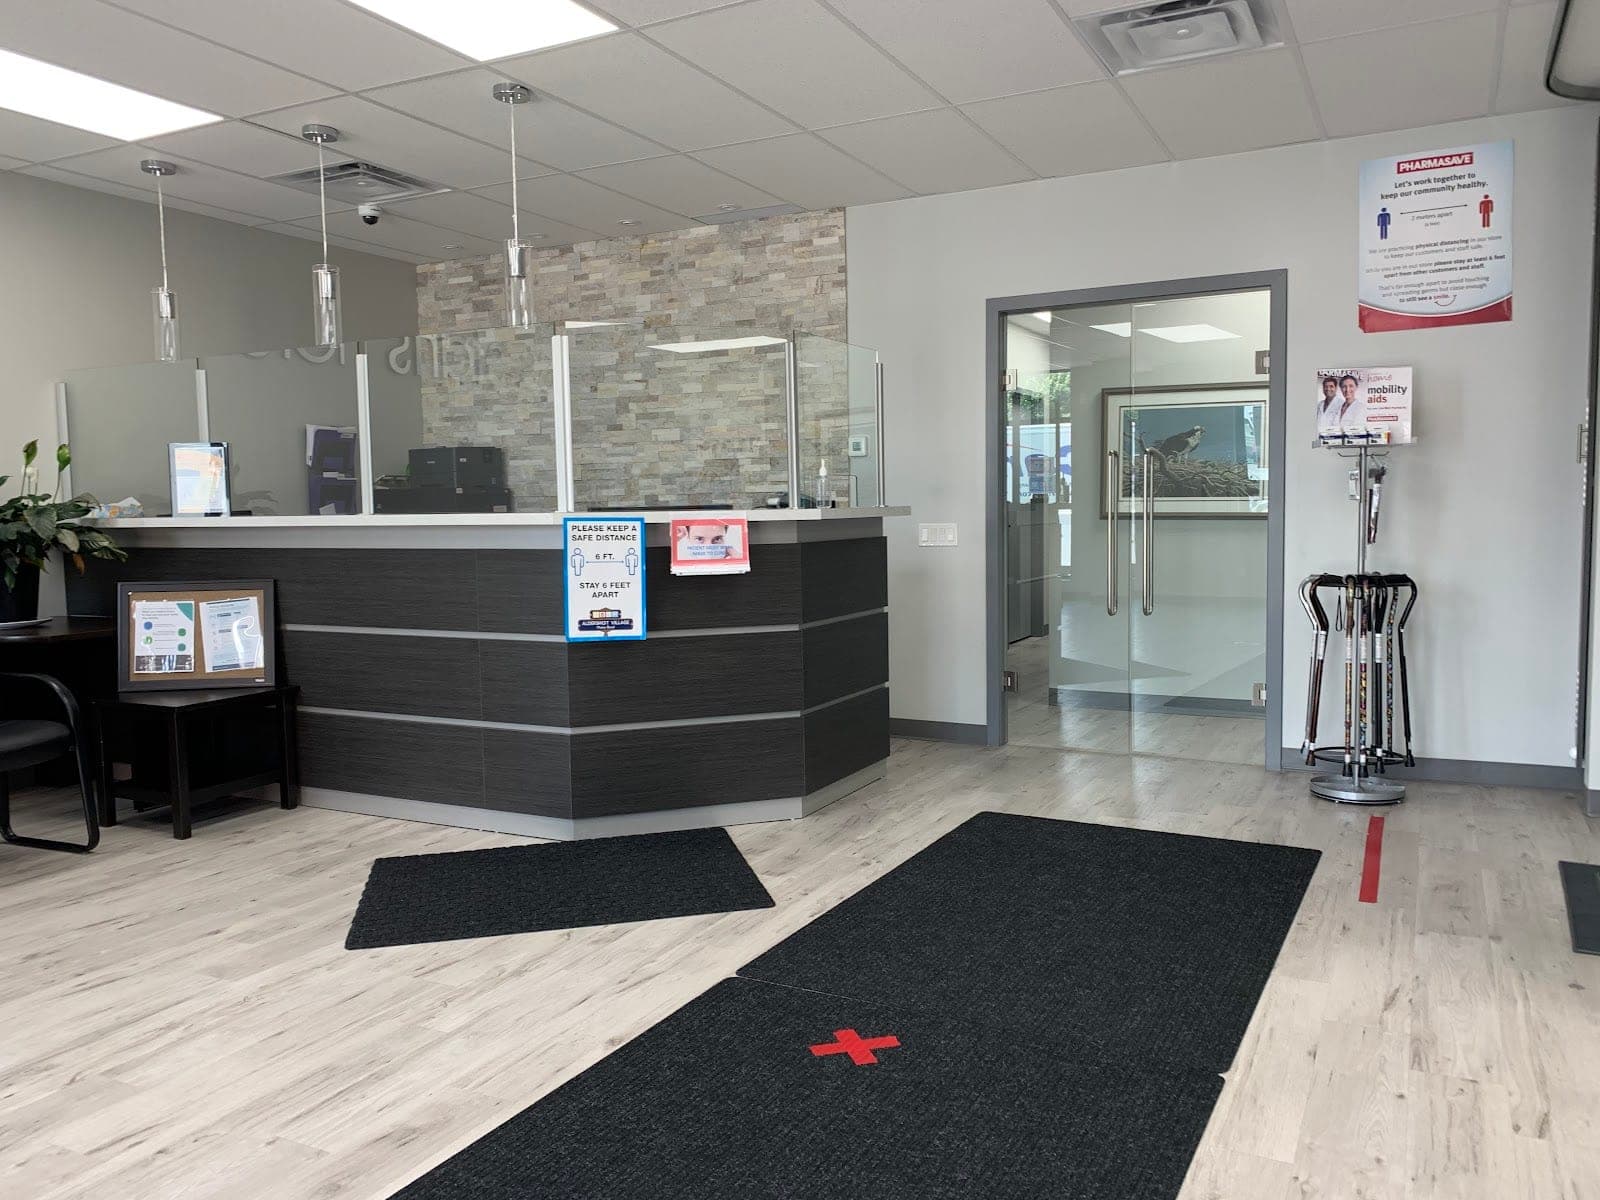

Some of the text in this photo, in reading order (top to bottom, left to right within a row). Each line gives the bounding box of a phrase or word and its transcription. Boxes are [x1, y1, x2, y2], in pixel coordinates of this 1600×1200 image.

[1399, 154, 1472, 172] PHARMASAVE
[1394, 181, 1413, 189] Let's
[1413, 178, 1432, 186] work
[1433, 175, 1466, 185] together
[1380, 193, 1399, 201] keep
[1413, 185, 1456, 196] community
[1457, 180, 1489, 191] healthy.
[1415, 241, 1439, 250] physical
[1440, 238, 1469, 247] distancing
[1453, 257, 1466, 265] stay
[1428, 266, 1458, 274] customers
[1367, 384, 1408, 395] mobility
[1367, 394, 1388, 404] aids
